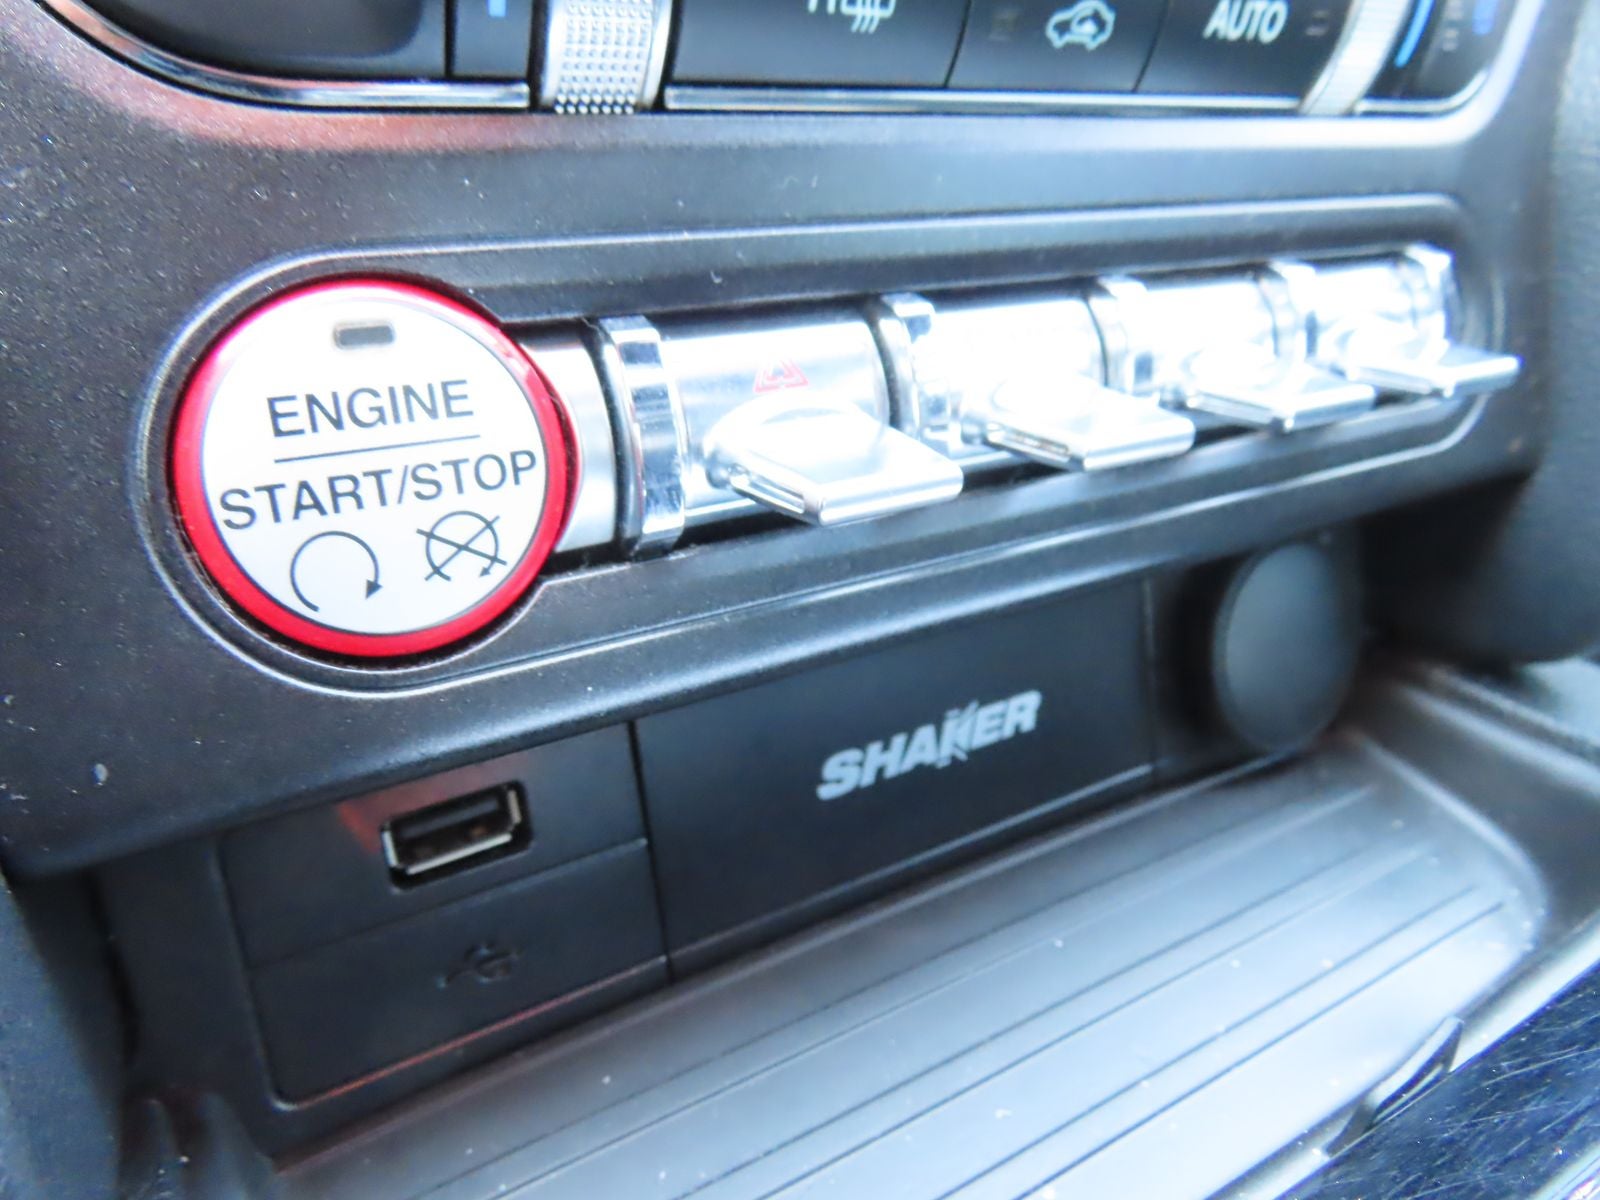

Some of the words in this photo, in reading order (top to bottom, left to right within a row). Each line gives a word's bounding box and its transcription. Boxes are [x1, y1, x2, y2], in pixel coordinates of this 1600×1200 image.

[1202, 0, 1288, 44] AUTO
[266, 379, 474, 437] ENGINE
[219, 449, 537, 530] START/STOP
[816, 689, 1042, 801] SHAKER
